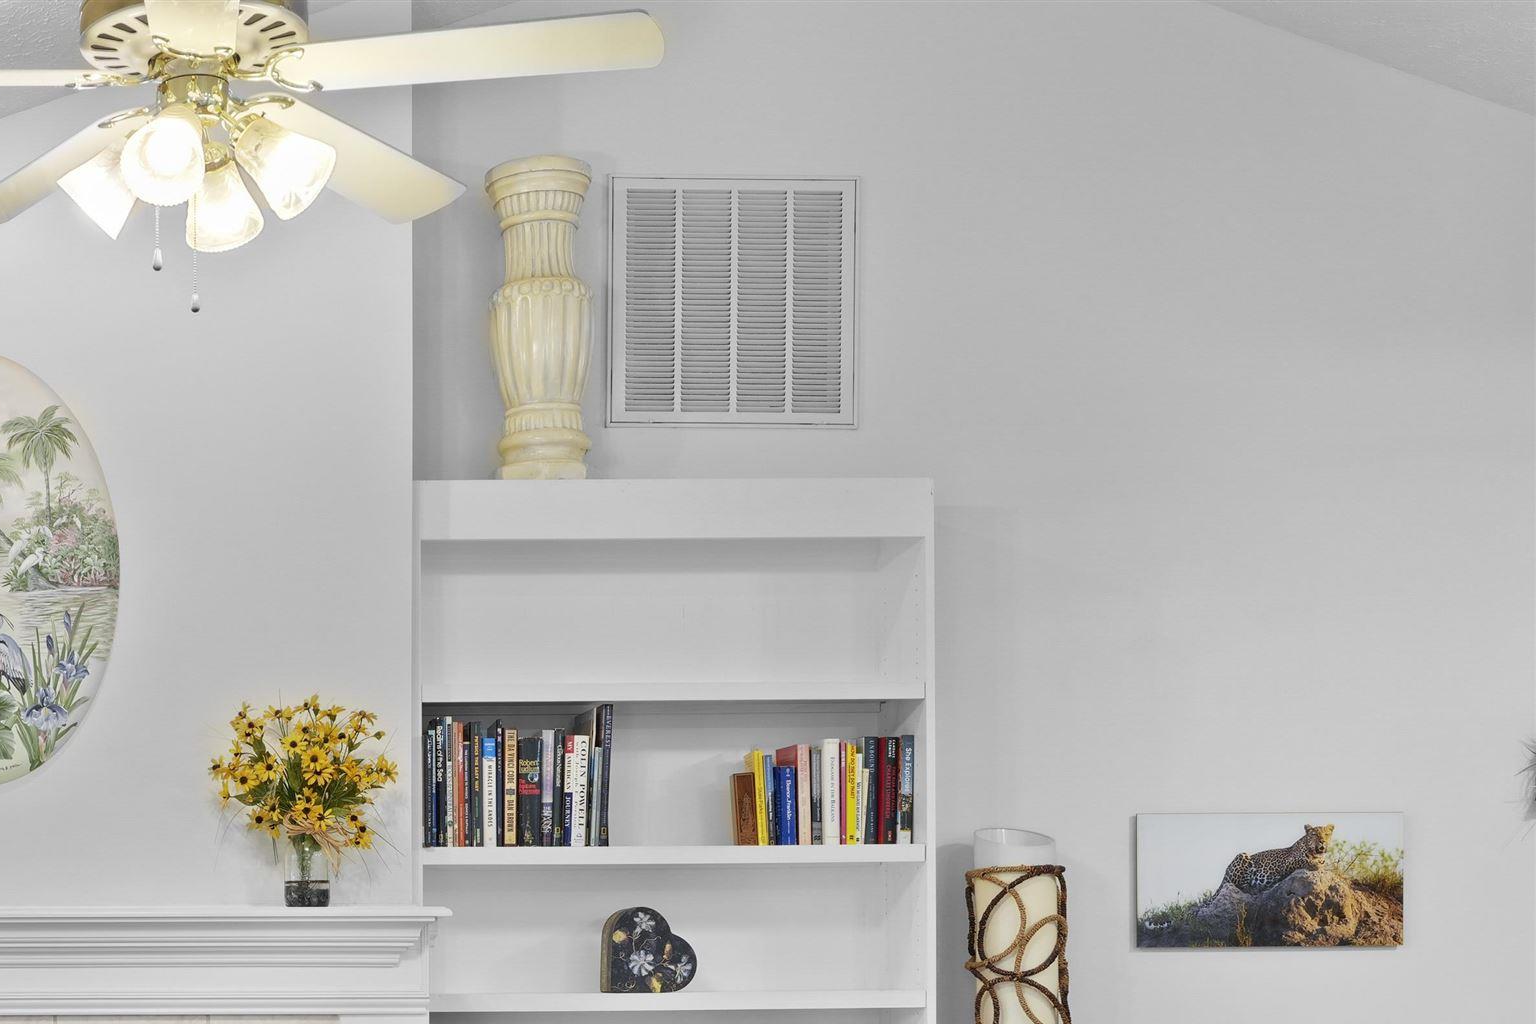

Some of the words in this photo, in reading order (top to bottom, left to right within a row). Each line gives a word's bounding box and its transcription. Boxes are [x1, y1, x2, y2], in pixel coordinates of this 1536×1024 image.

[604, 715, 612, 748] EVEREST
[508, 744, 514, 752] DA
[566, 741, 572, 752] MY
[578, 784, 586, 829] POWELL
